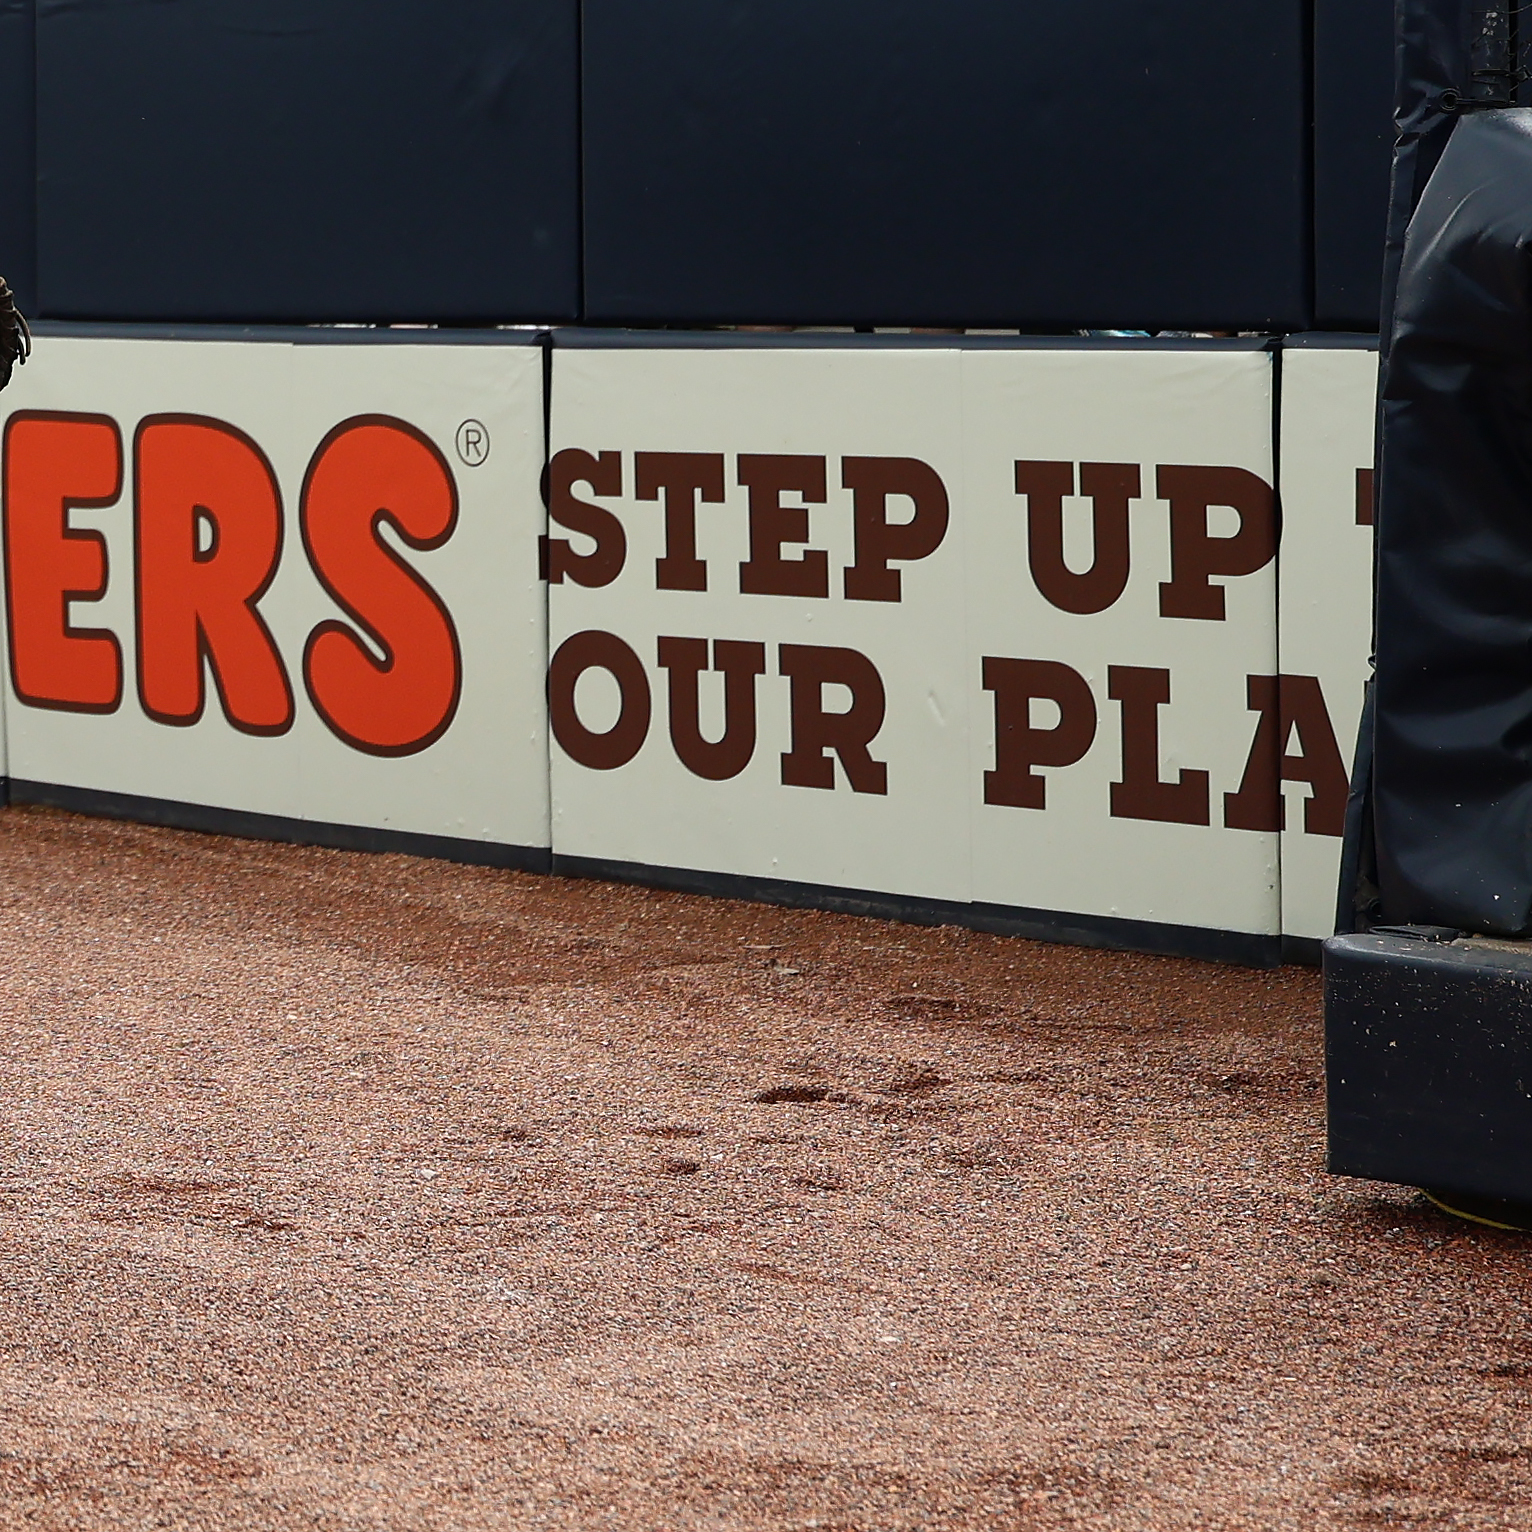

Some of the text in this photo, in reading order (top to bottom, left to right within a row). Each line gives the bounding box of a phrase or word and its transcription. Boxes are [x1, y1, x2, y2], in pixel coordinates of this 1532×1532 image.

[538, 447, 1283, 622] STEP UP
[548, 629, 1376, 838] OUR PLA
